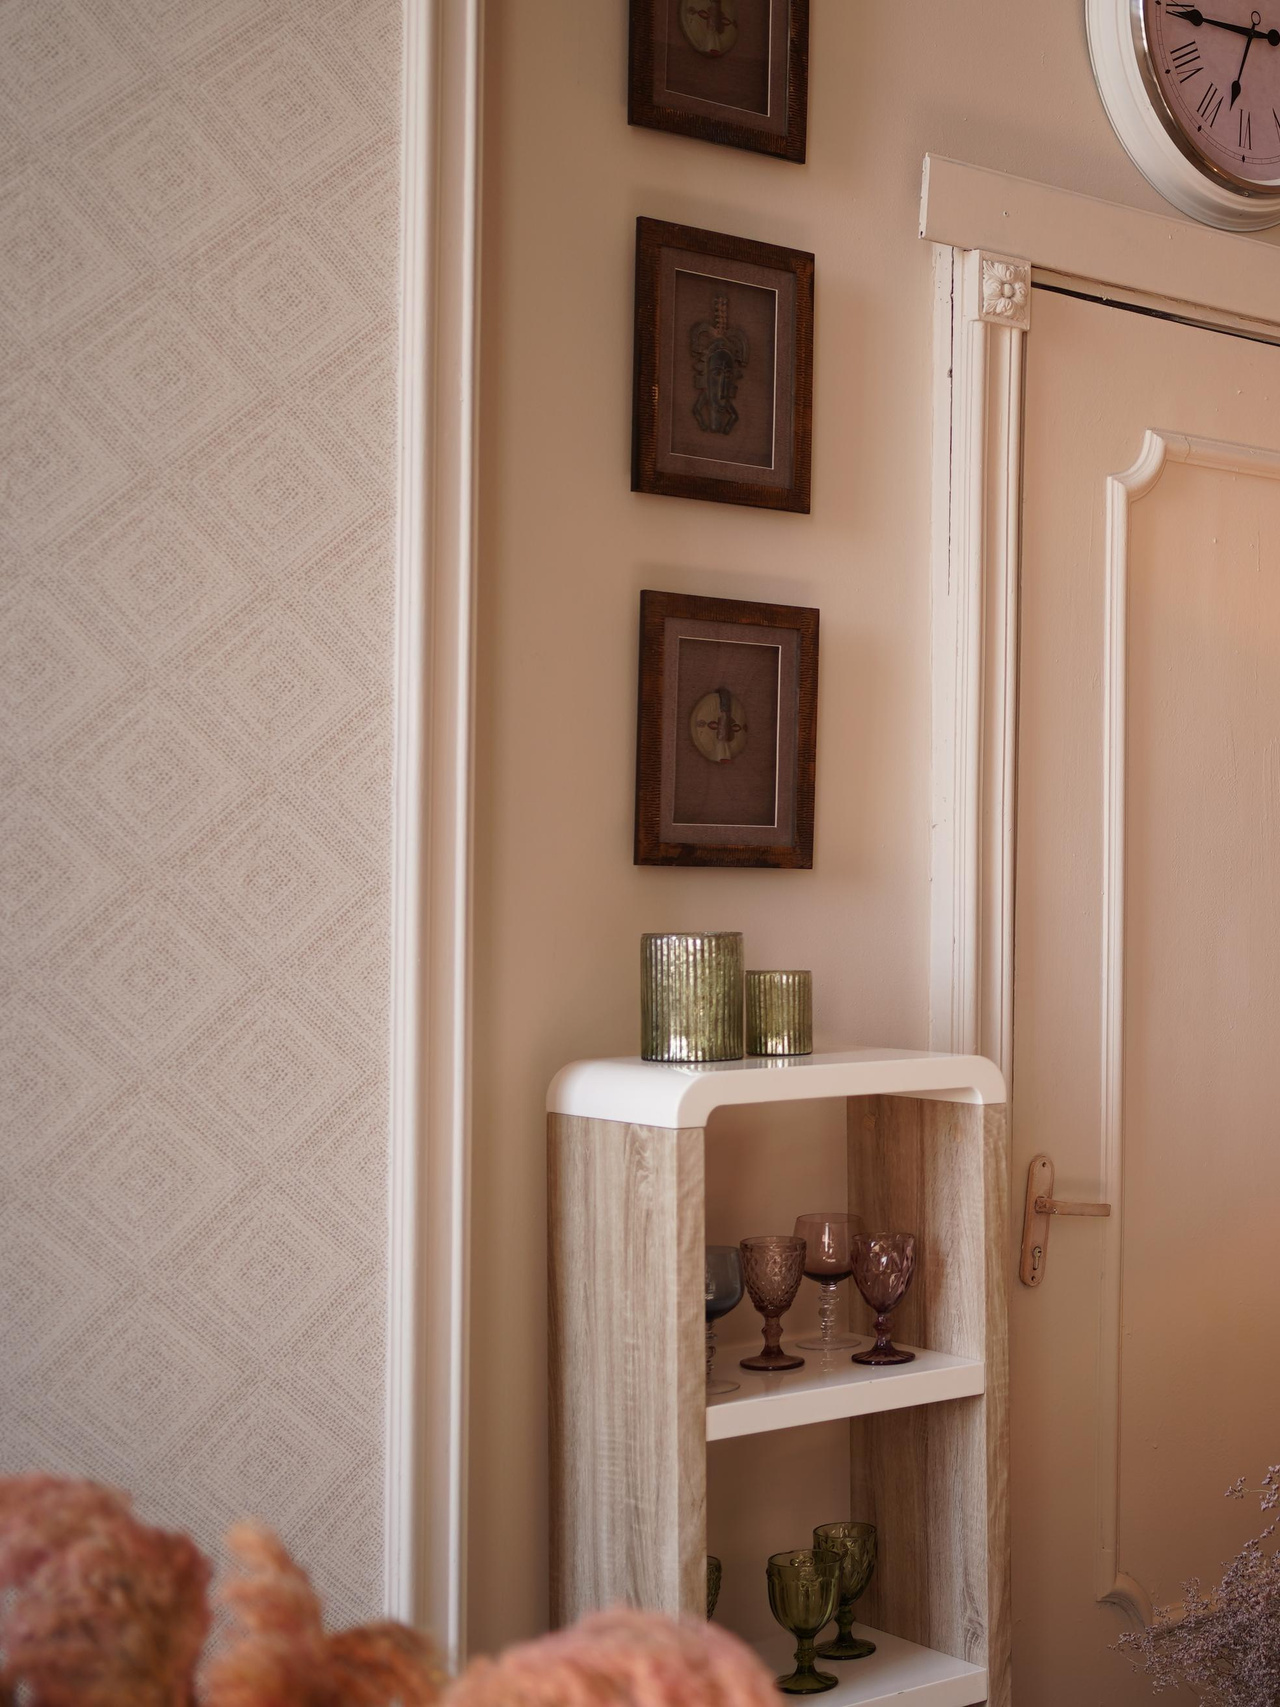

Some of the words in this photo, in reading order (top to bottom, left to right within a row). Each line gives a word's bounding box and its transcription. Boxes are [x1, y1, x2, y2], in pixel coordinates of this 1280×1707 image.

[1170, 41, 1204, 84] VIII
[1196, 82, 1224, 128] VII
[1238, 108, 1252, 150] VI
